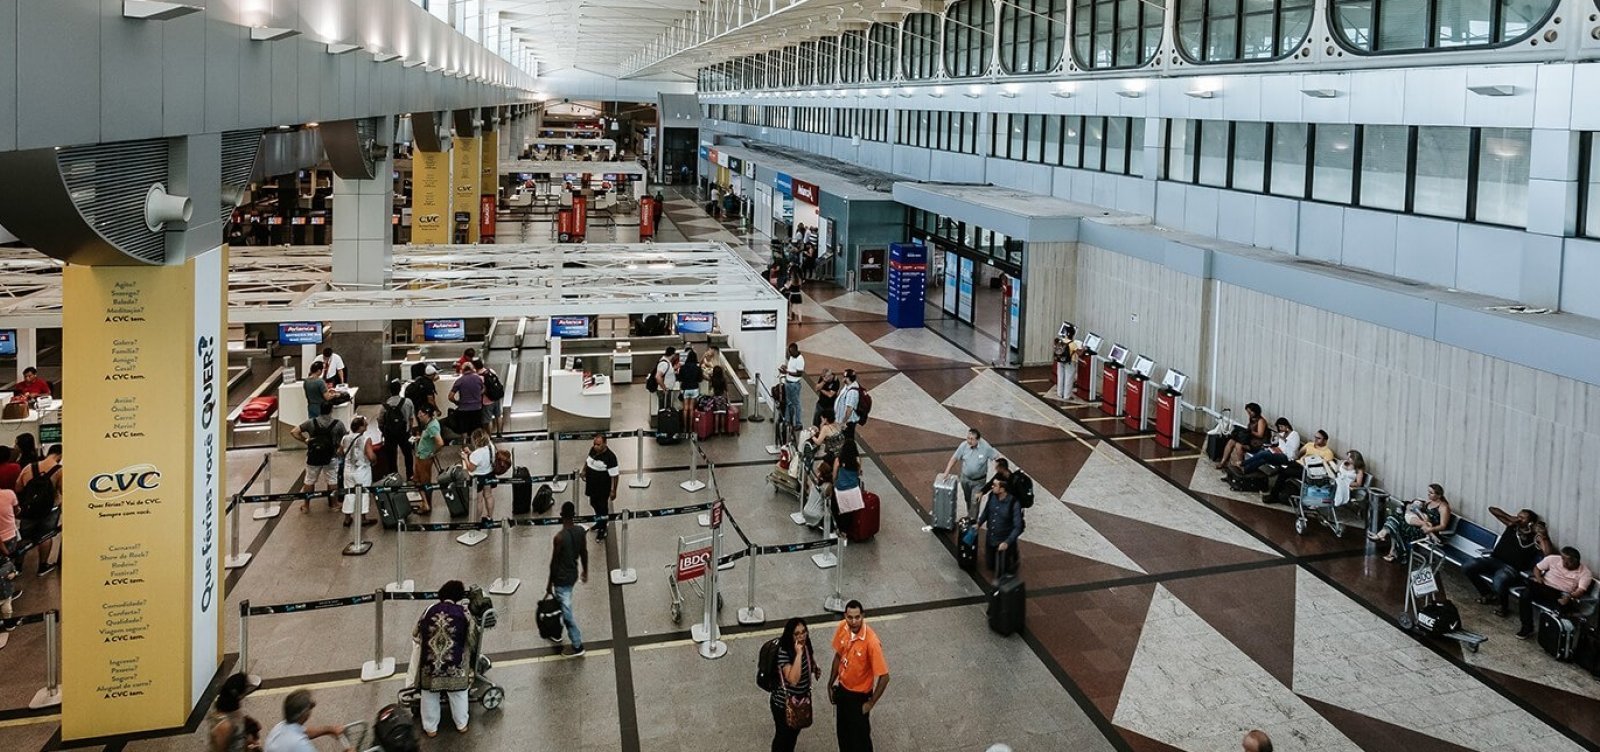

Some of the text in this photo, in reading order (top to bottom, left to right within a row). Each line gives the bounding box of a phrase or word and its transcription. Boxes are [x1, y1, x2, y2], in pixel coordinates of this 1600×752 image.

[198, 335, 216, 613] Que férias você QUER?
[89, 471, 161, 493] CVC
[108, 608, 141, 617] Conforto?
[106, 617, 143, 626] Qualidade?
